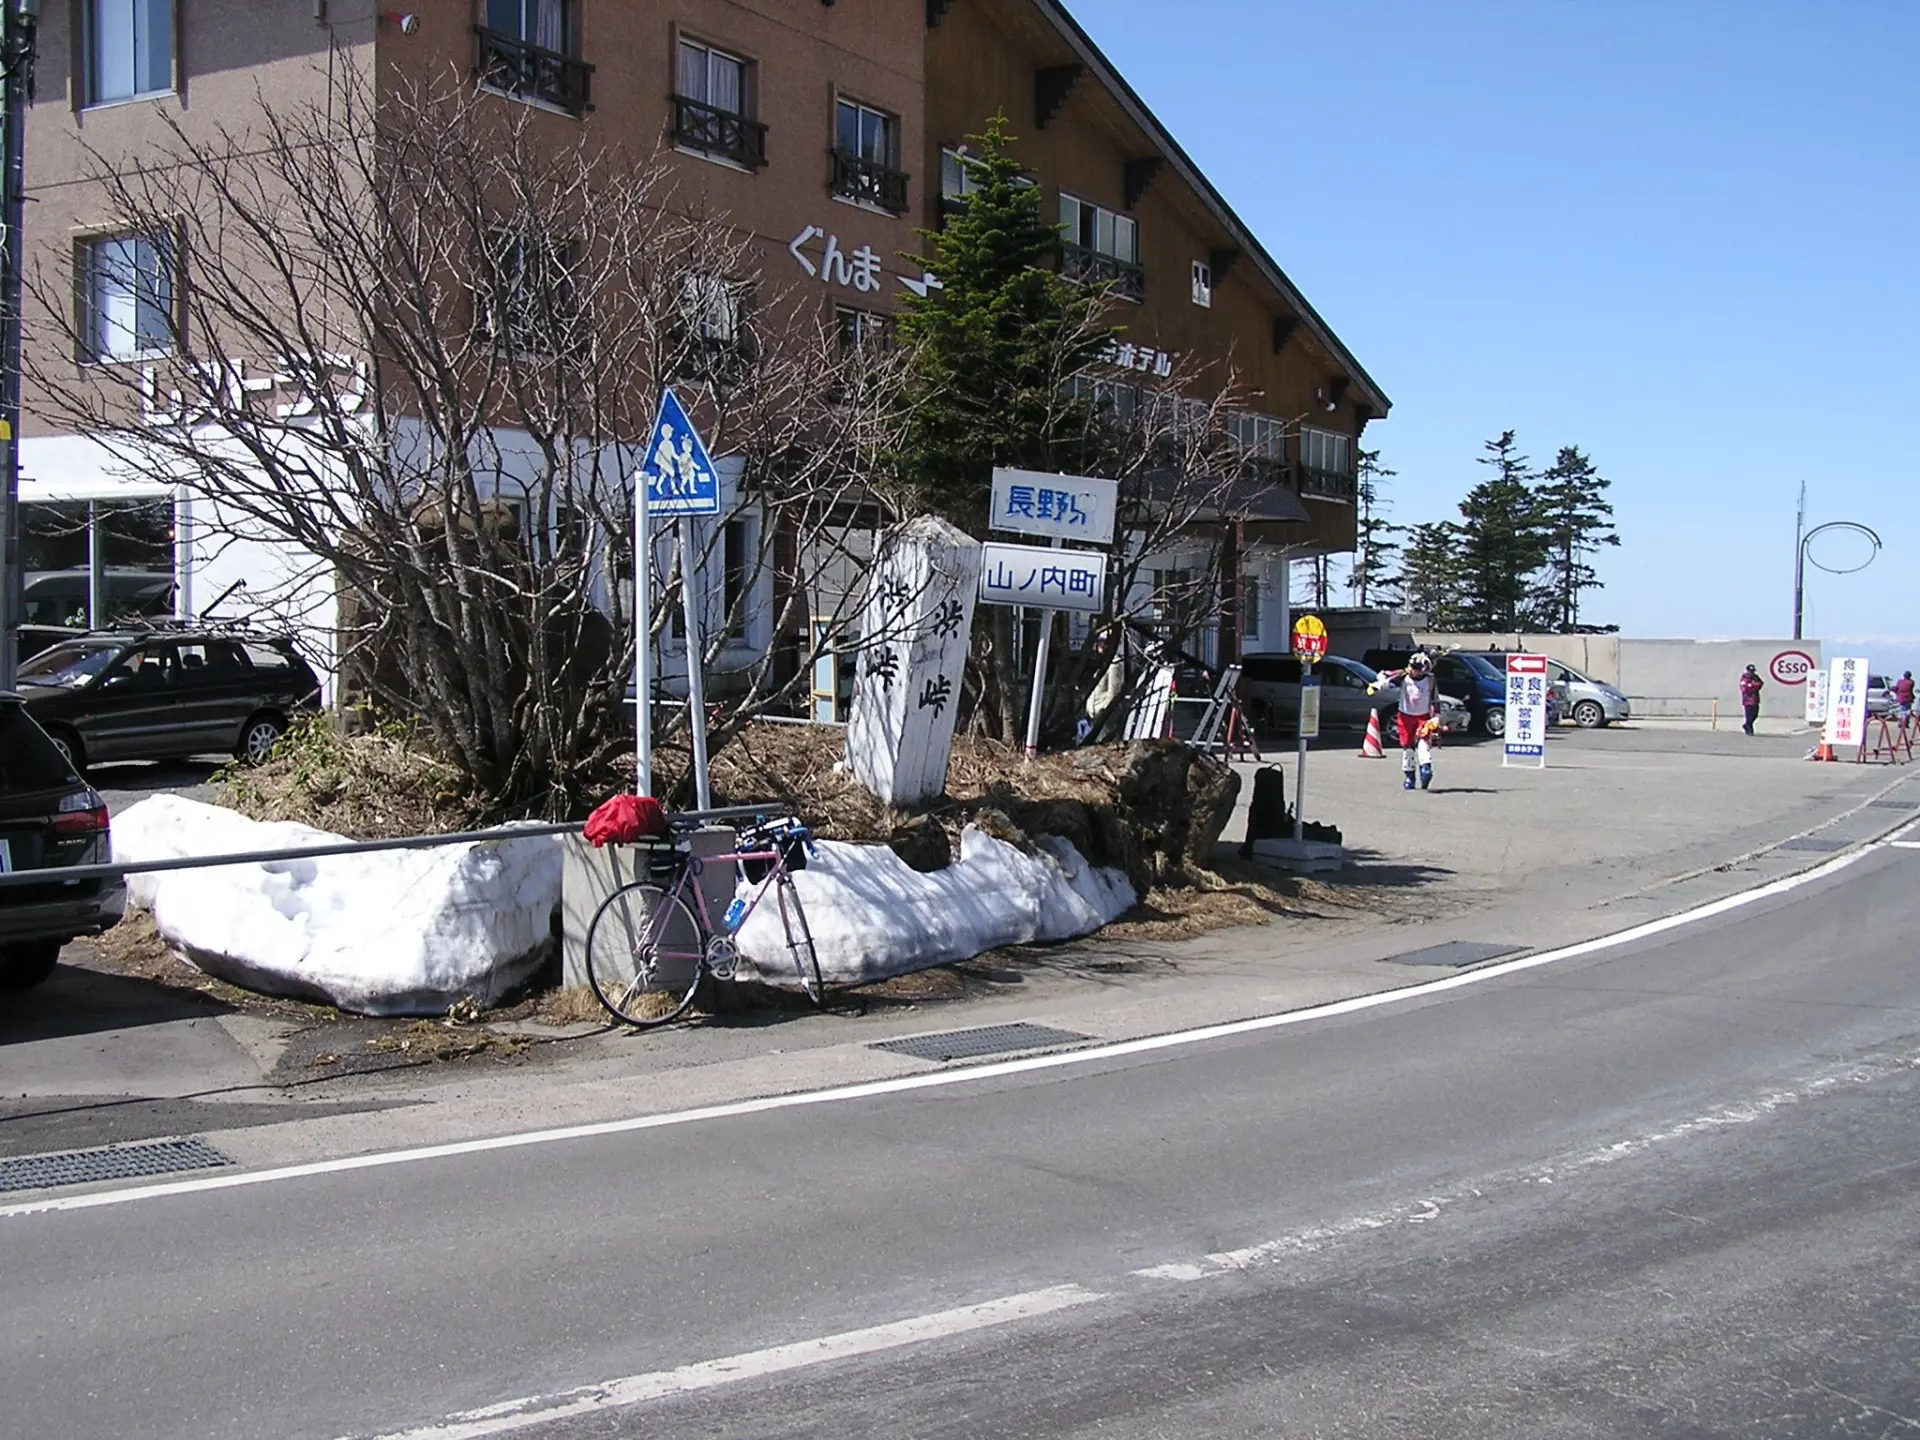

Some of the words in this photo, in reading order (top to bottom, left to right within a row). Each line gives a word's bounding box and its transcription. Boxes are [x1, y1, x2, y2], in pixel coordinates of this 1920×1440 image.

[788, 225, 881, 292] ぐんま
[1097, 342, 1172, 377] ホテル
[987, 561, 1097, 598] 山ノ内町
[918, 600, 963, 719] 渋峠
[1510, 676, 1524, 705] 喫茶
[1527, 676, 1542, 706] 食堂
[1517, 707, 1532, 742] 営業中
